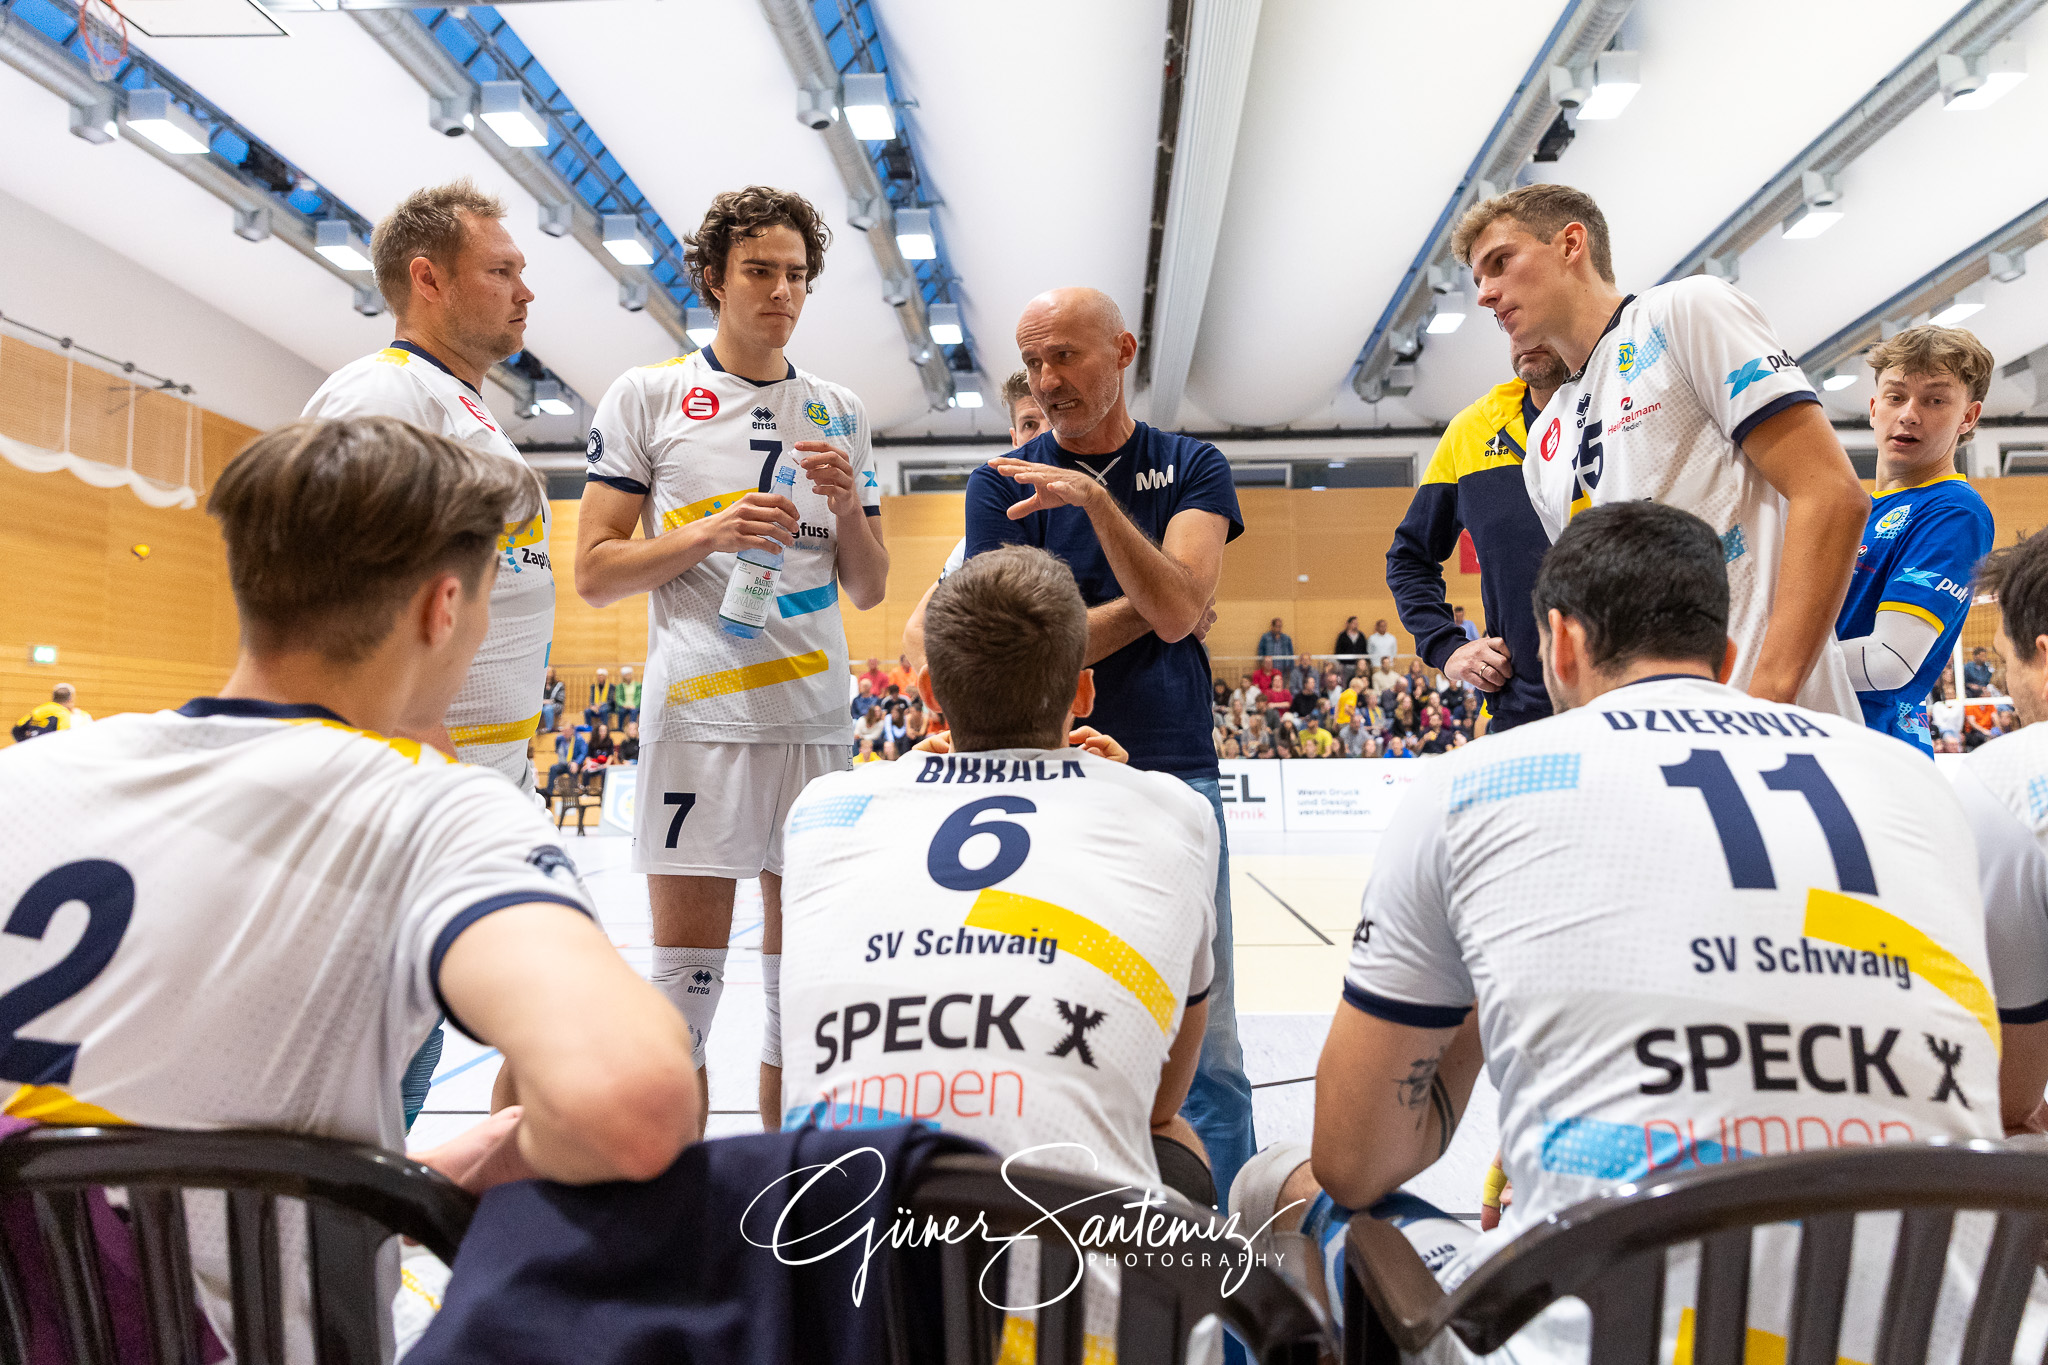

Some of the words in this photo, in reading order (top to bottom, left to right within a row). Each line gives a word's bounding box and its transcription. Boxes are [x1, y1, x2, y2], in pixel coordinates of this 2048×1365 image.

[749, 439, 783, 493] 7
[1484, 447, 1509, 457] erea
[1602, 709, 1830, 738] DZIERWA
[663, 792, 696, 849] 7
[927, 795, 1037, 891] 6
[1658, 748, 1880, 897] 11
[0, 858, 136, 1084] 2
[865, 931, 904, 962] SV
[914, 927, 1058, 964] Schwaig
[1690, 936, 1738, 973] SV
[1753, 937, 1912, 989] Schwaig
[815, 994, 1031, 1075] SPECK
[1635, 1022, 1909, 1098] SPECK
